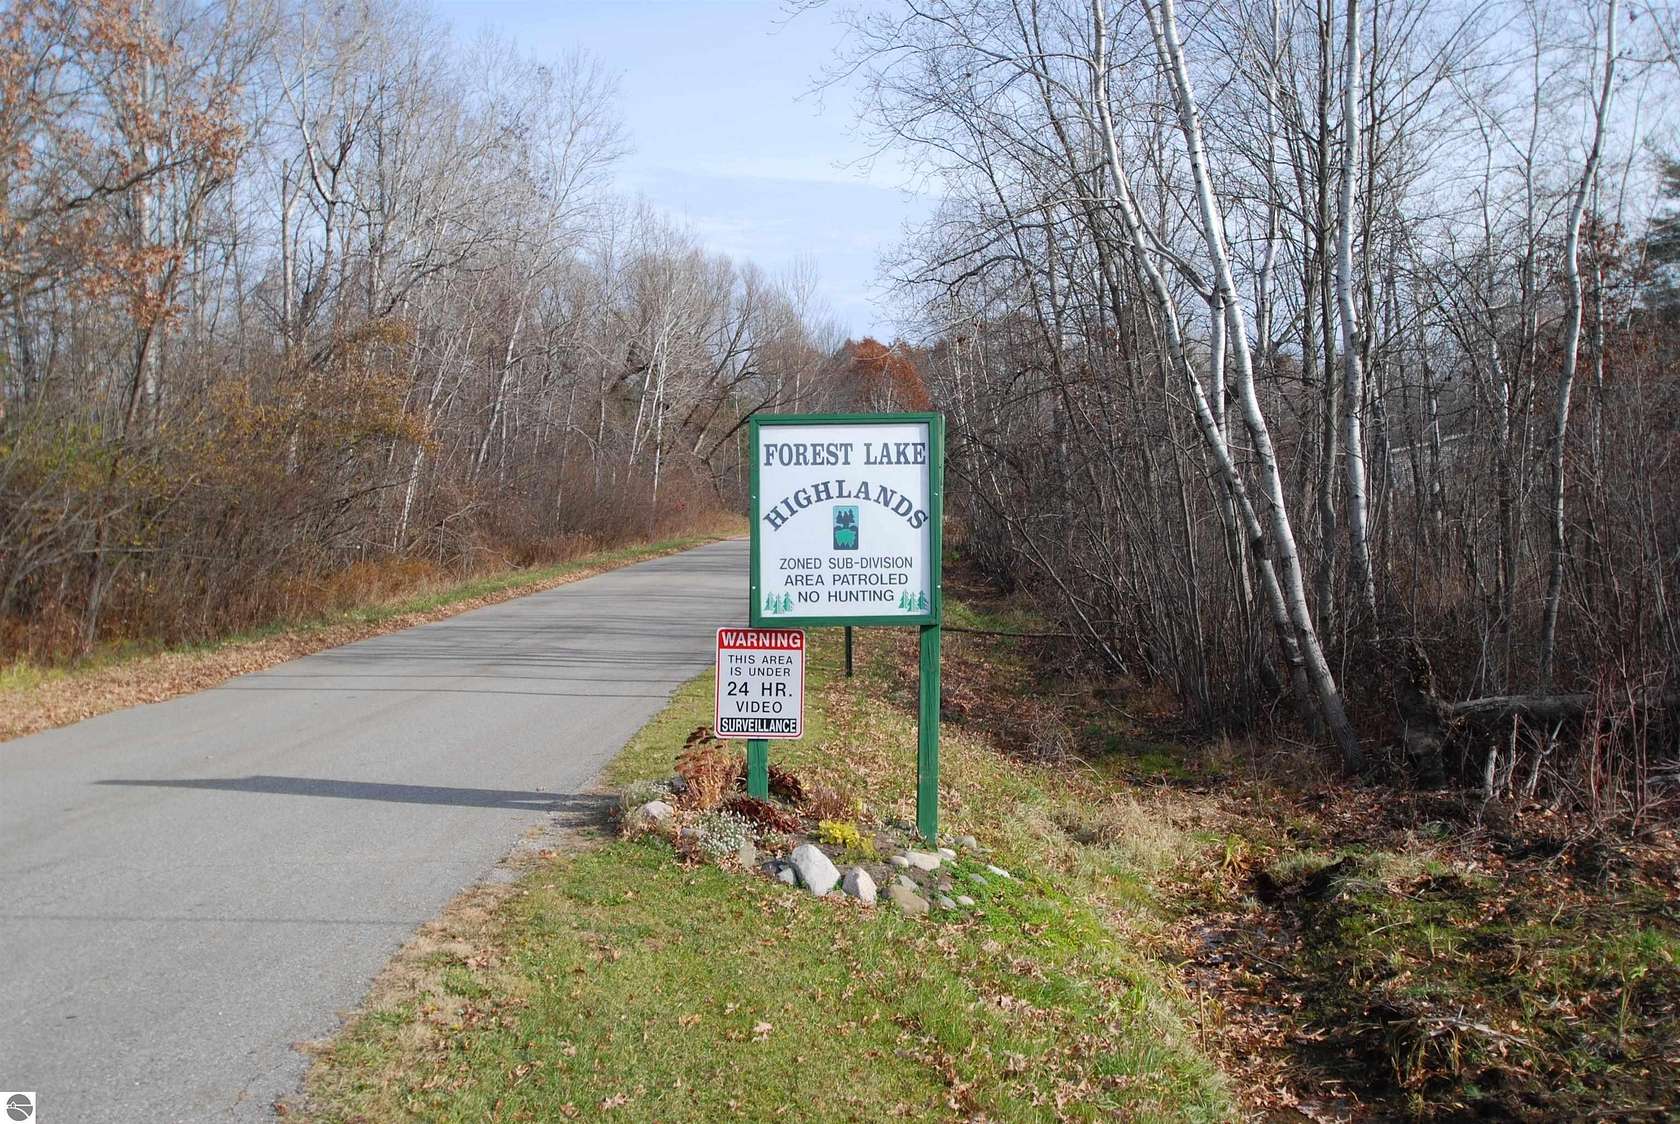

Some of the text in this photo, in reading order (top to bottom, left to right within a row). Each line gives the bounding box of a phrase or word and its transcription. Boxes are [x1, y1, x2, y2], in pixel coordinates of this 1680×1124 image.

[764, 443, 926, 466] FOREST LAKE
[763, 480, 928, 531] HIGHLANDS
[780, 557, 913, 569] ZONED SUB-DIVISION
[785, 574, 908, 586] AREA PATROLED
[798, 590, 894, 602] NO HUNTING
[722, 632, 800, 647] WARNING
[728, 655, 792, 664] THIS AREA
[731, 667, 790, 676] IS UNDER
[728, 682, 792, 696] 24 HR.
[736, 701, 782, 713] VIDEO
[722, 719, 796, 732] SURVEILLANCE
